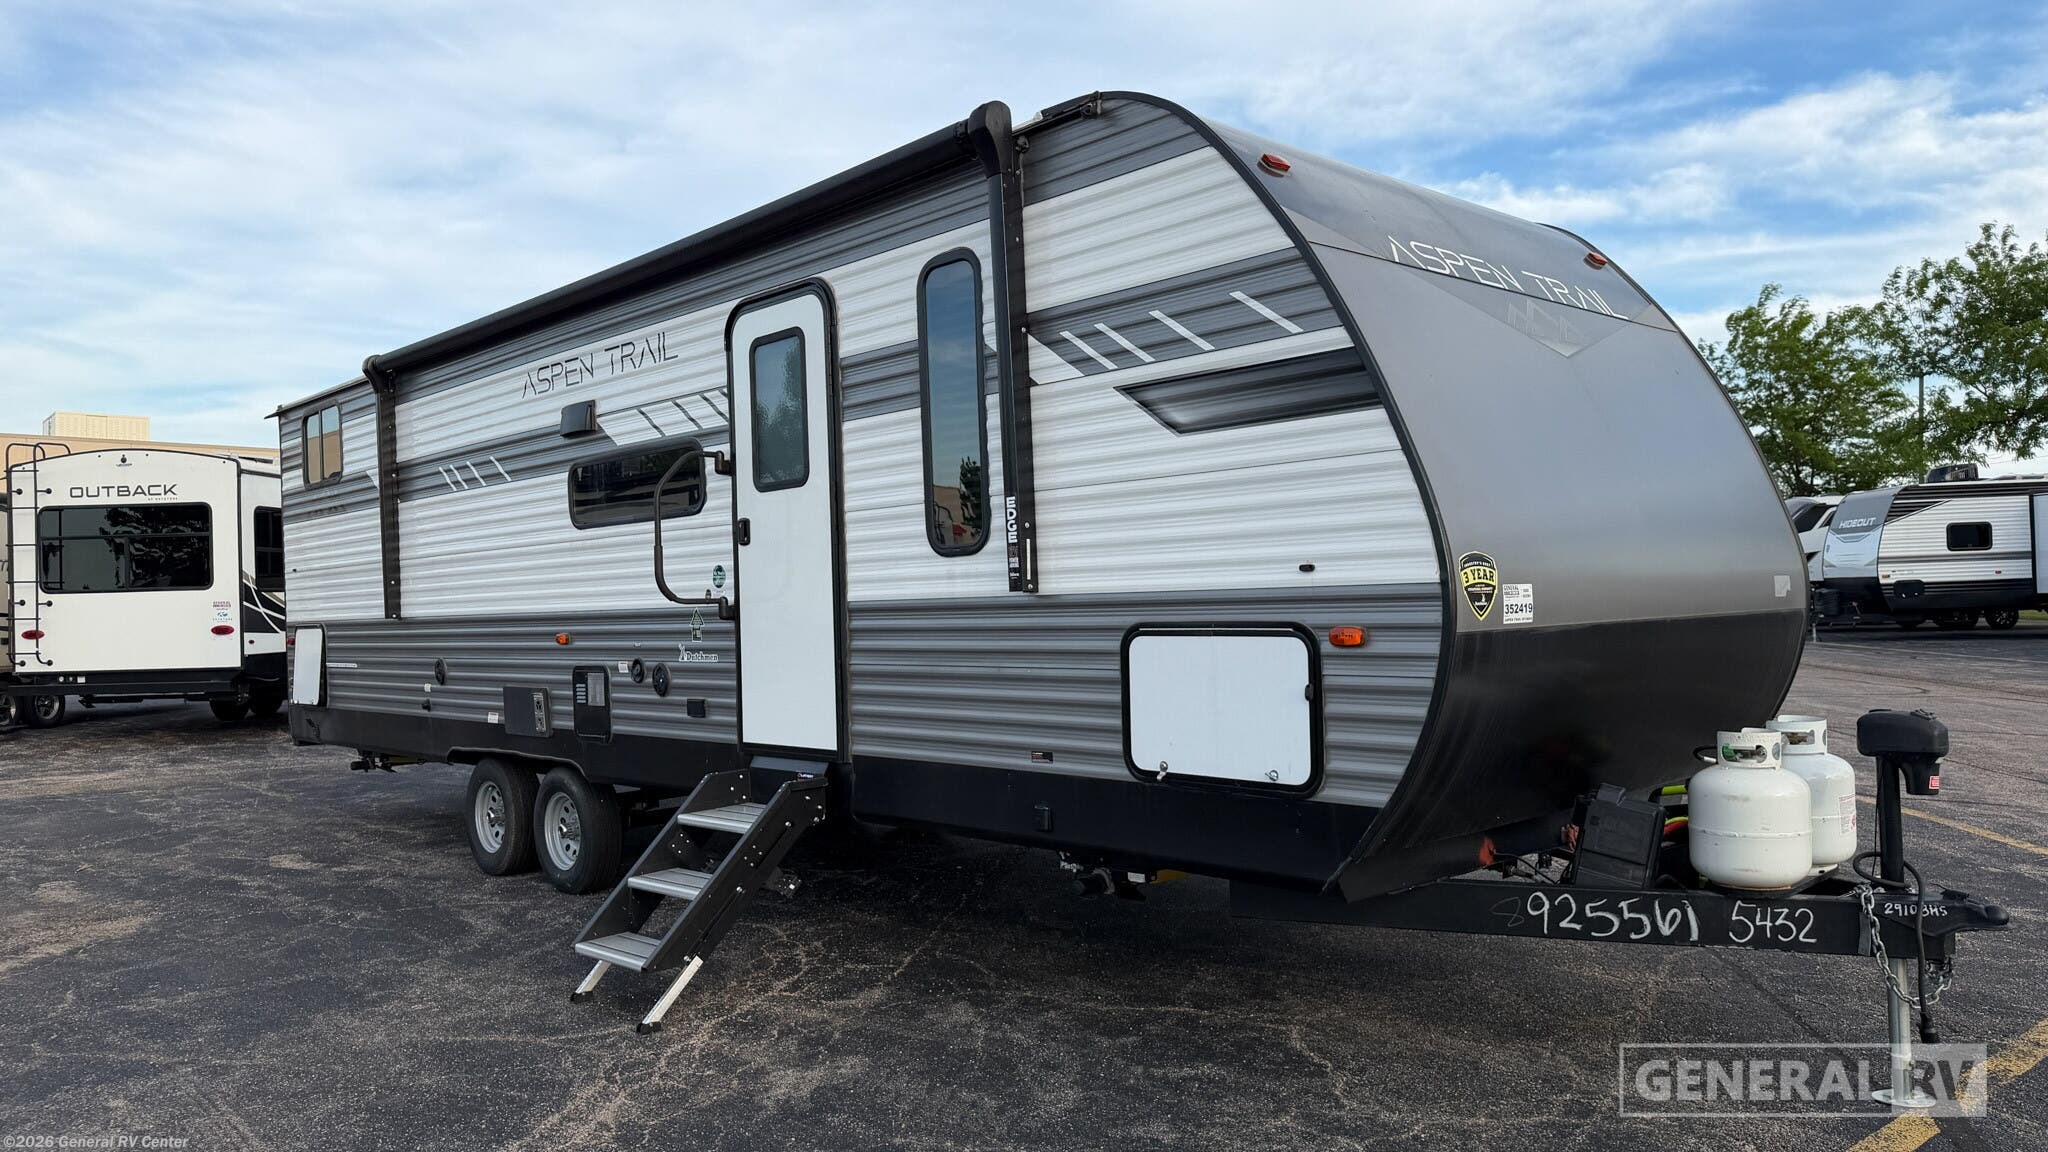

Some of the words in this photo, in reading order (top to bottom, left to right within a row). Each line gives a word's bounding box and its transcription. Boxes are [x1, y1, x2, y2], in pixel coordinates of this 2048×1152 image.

[1387, 235, 1524, 292] ASPEN
[1521, 270, 1629, 320] TRAIL
[522, 352, 594, 399] ASPEN
[604, 331, 679, 375] TRAIL
[69, 483, 178, 499] OUTBACK
[1006, 497, 1018, 543] EDGE
[1839, 517, 1876, 528] HIDEOUT
[1463, 571, 1470, 584] 3
[1470, 568, 1494, 582] YEAR
[1504, 602, 1533, 615] 352419
[686, 652, 719, 662] Dutchmen
[1728, 900, 1818, 944] 5432
